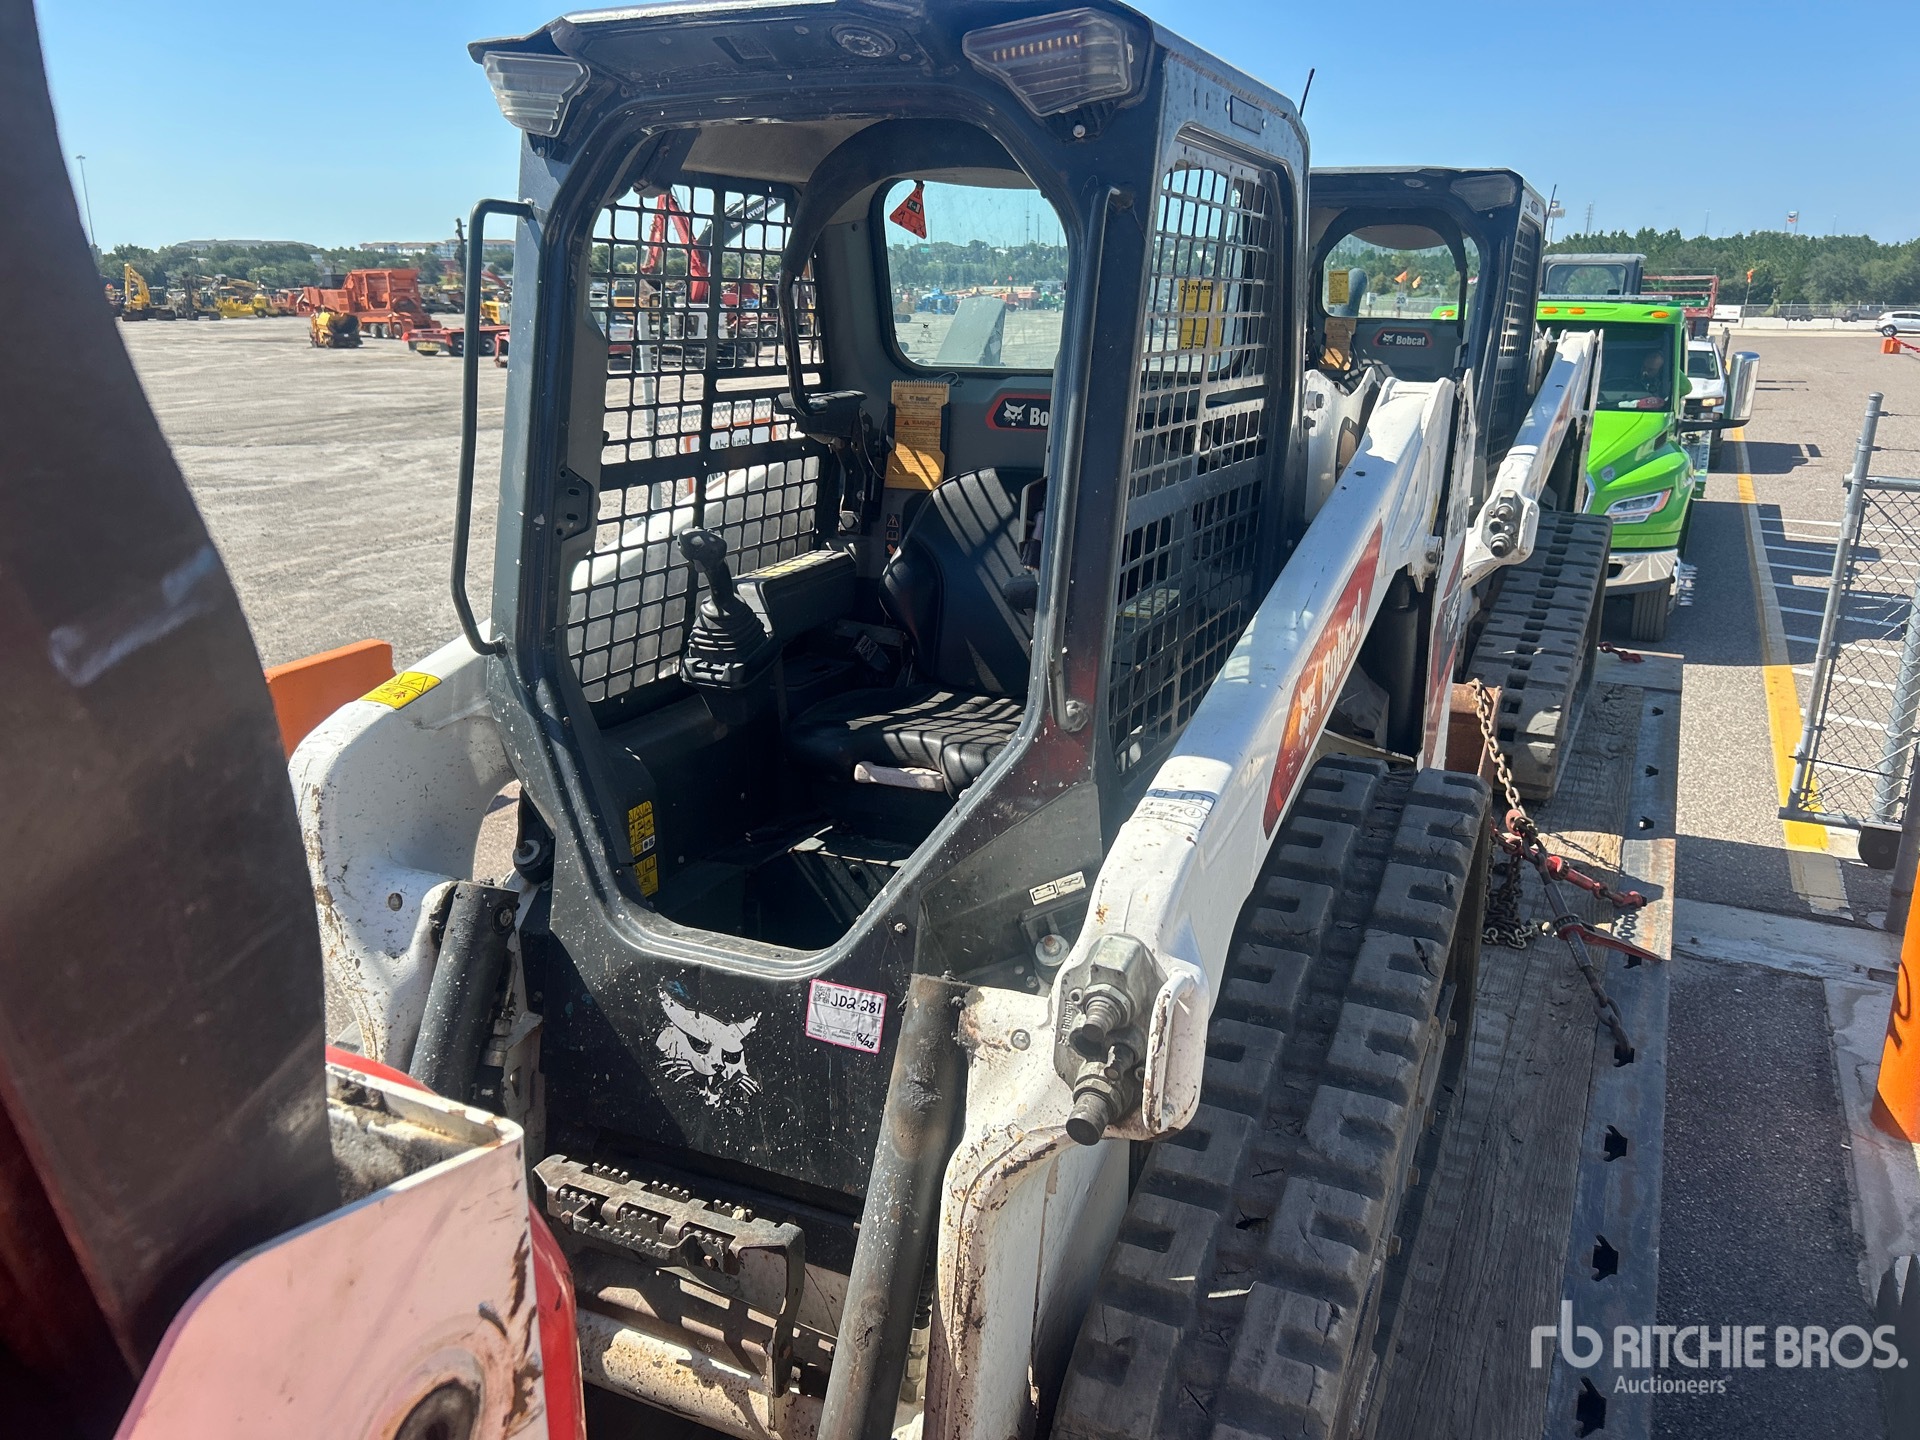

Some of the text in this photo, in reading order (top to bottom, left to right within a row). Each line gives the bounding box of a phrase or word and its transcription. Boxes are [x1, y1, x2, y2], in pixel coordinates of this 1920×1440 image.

[746, 197, 777, 219] HYUNAI
[1396, 296, 1406, 304] 20
[1395, 335, 1426, 346] Bobcat
